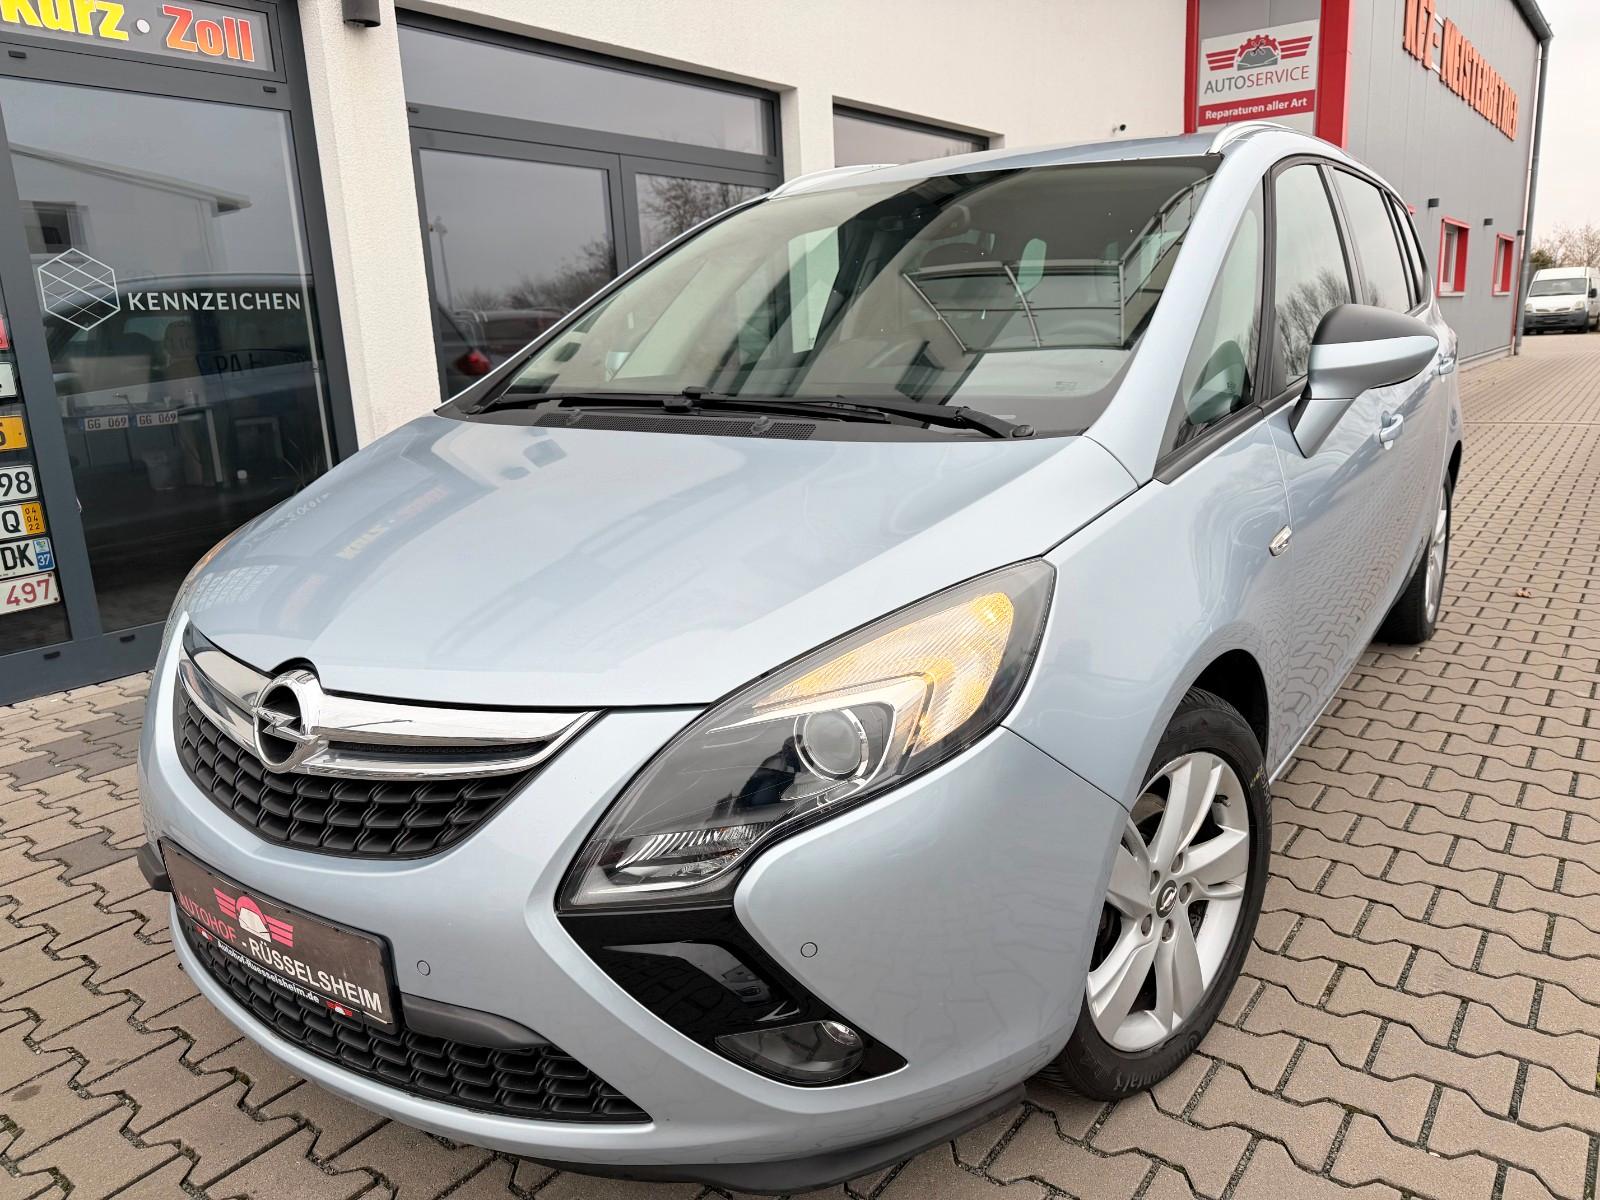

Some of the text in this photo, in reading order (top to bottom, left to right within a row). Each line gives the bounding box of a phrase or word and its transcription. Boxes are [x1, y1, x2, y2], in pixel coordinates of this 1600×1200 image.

[0, 0, 255, 62] Kurz Zoll
[1204, 65, 1310, 95] AUTOSERVICE
[1205, 97, 1308, 120] Reparaturen aller Art
[128, 292, 302, 312] KENNZEICHEN
[0, 471, 32, 496] 98
[1, 510, 21, 533] Q
[1, 542, 50, 571] DK 37
[6, 578, 50, 606] 497
